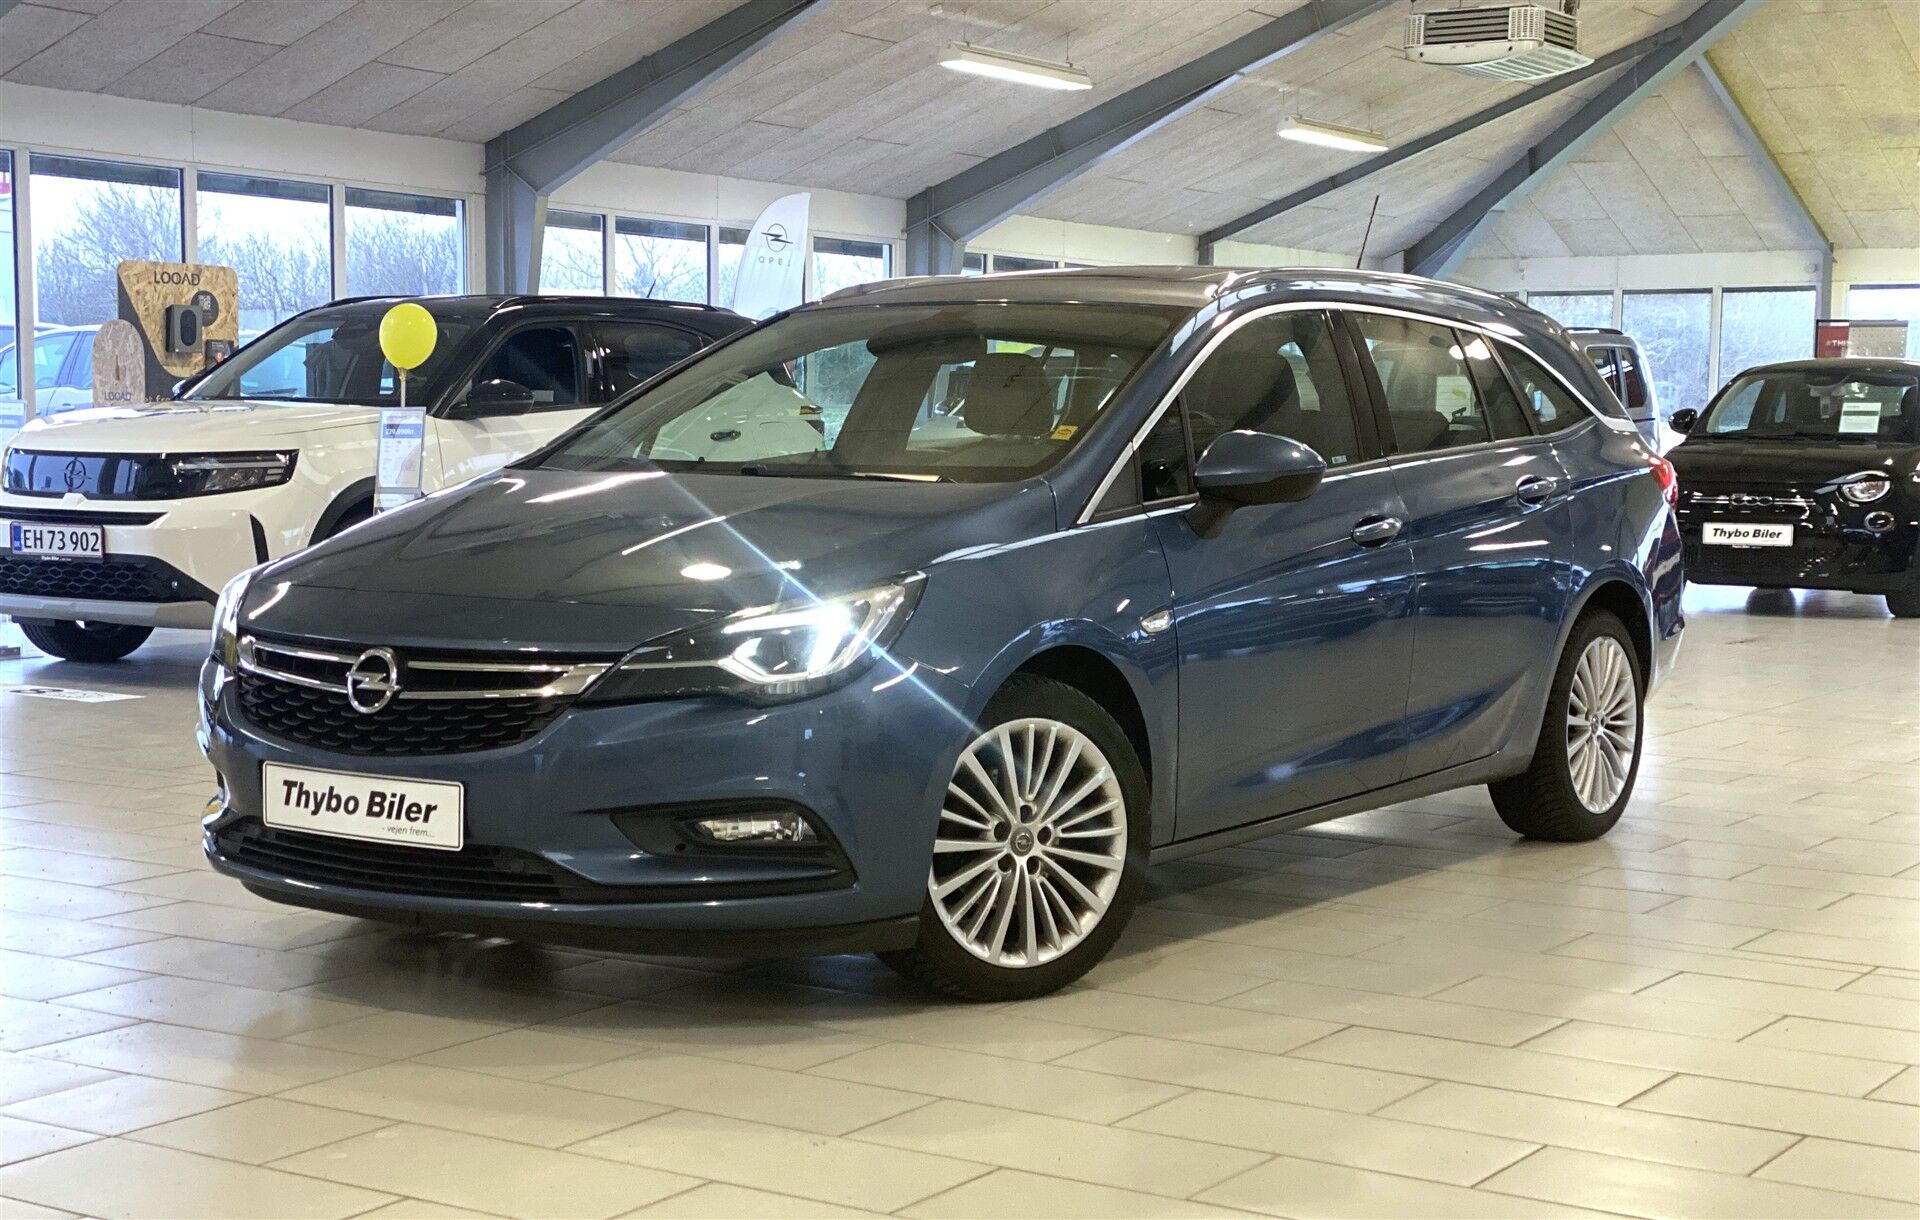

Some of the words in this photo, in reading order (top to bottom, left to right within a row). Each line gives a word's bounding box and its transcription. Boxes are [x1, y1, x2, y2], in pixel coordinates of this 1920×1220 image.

[153, 271, 200, 286] LOOAD
[104, 391, 132, 401] LOOAD
[1713, 528, 1750, 539] Thybo
[1752, 529, 1783, 539] Biler
[23, 529, 44, 549] EH
[47, 530, 66, 551] 73
[69, 531, 100, 552] 902
[282, 779, 360, 817] Thybo
[365, 790, 439, 824] Biler
[386, 825, 409, 836] vejen
